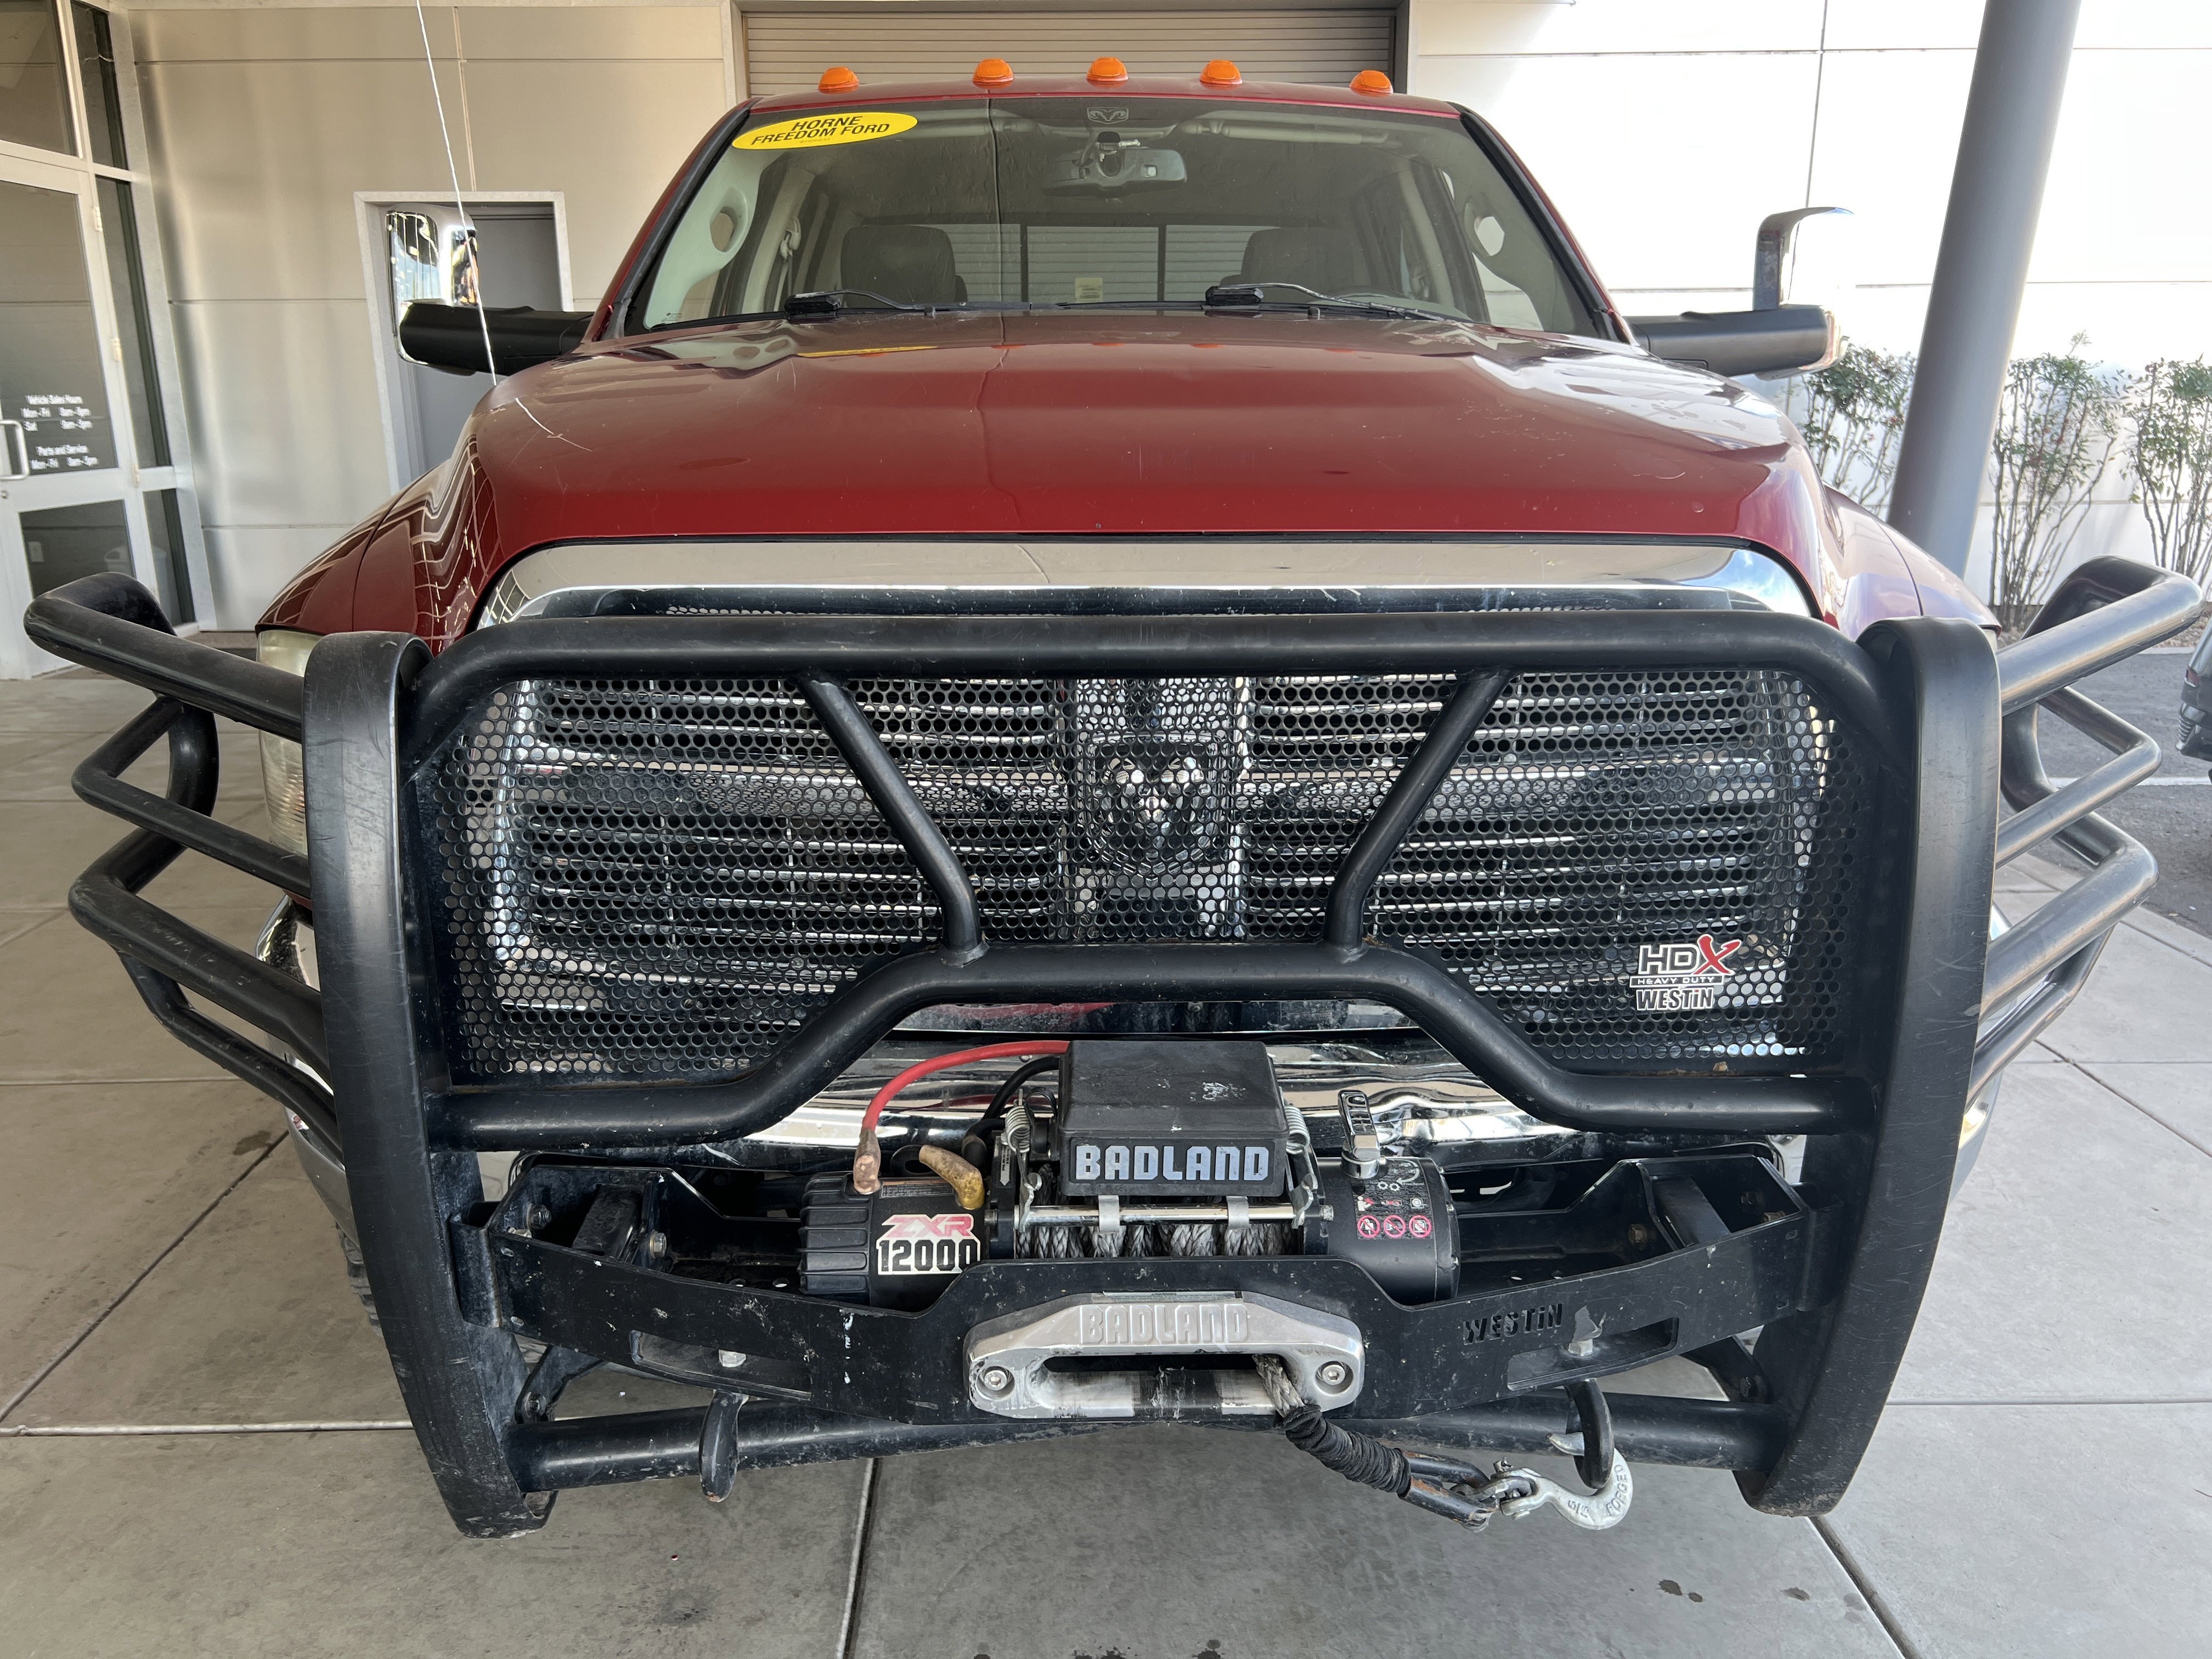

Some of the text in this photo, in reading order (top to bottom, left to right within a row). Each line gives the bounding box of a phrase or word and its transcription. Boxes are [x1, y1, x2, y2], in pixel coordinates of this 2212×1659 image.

[751, 128, 837, 145] FREEDOM
[841, 123, 890, 136] FORD
[792, 116, 862, 131] HORNE
[1638, 934, 1742, 975] HDX
[1076, 1145, 1269, 1181] BADLAND
[884, 1215, 973, 1238] ZXR
[879, 1239, 978, 1272] 12000
[1080, 1304, 1248, 1344] BADLAND
